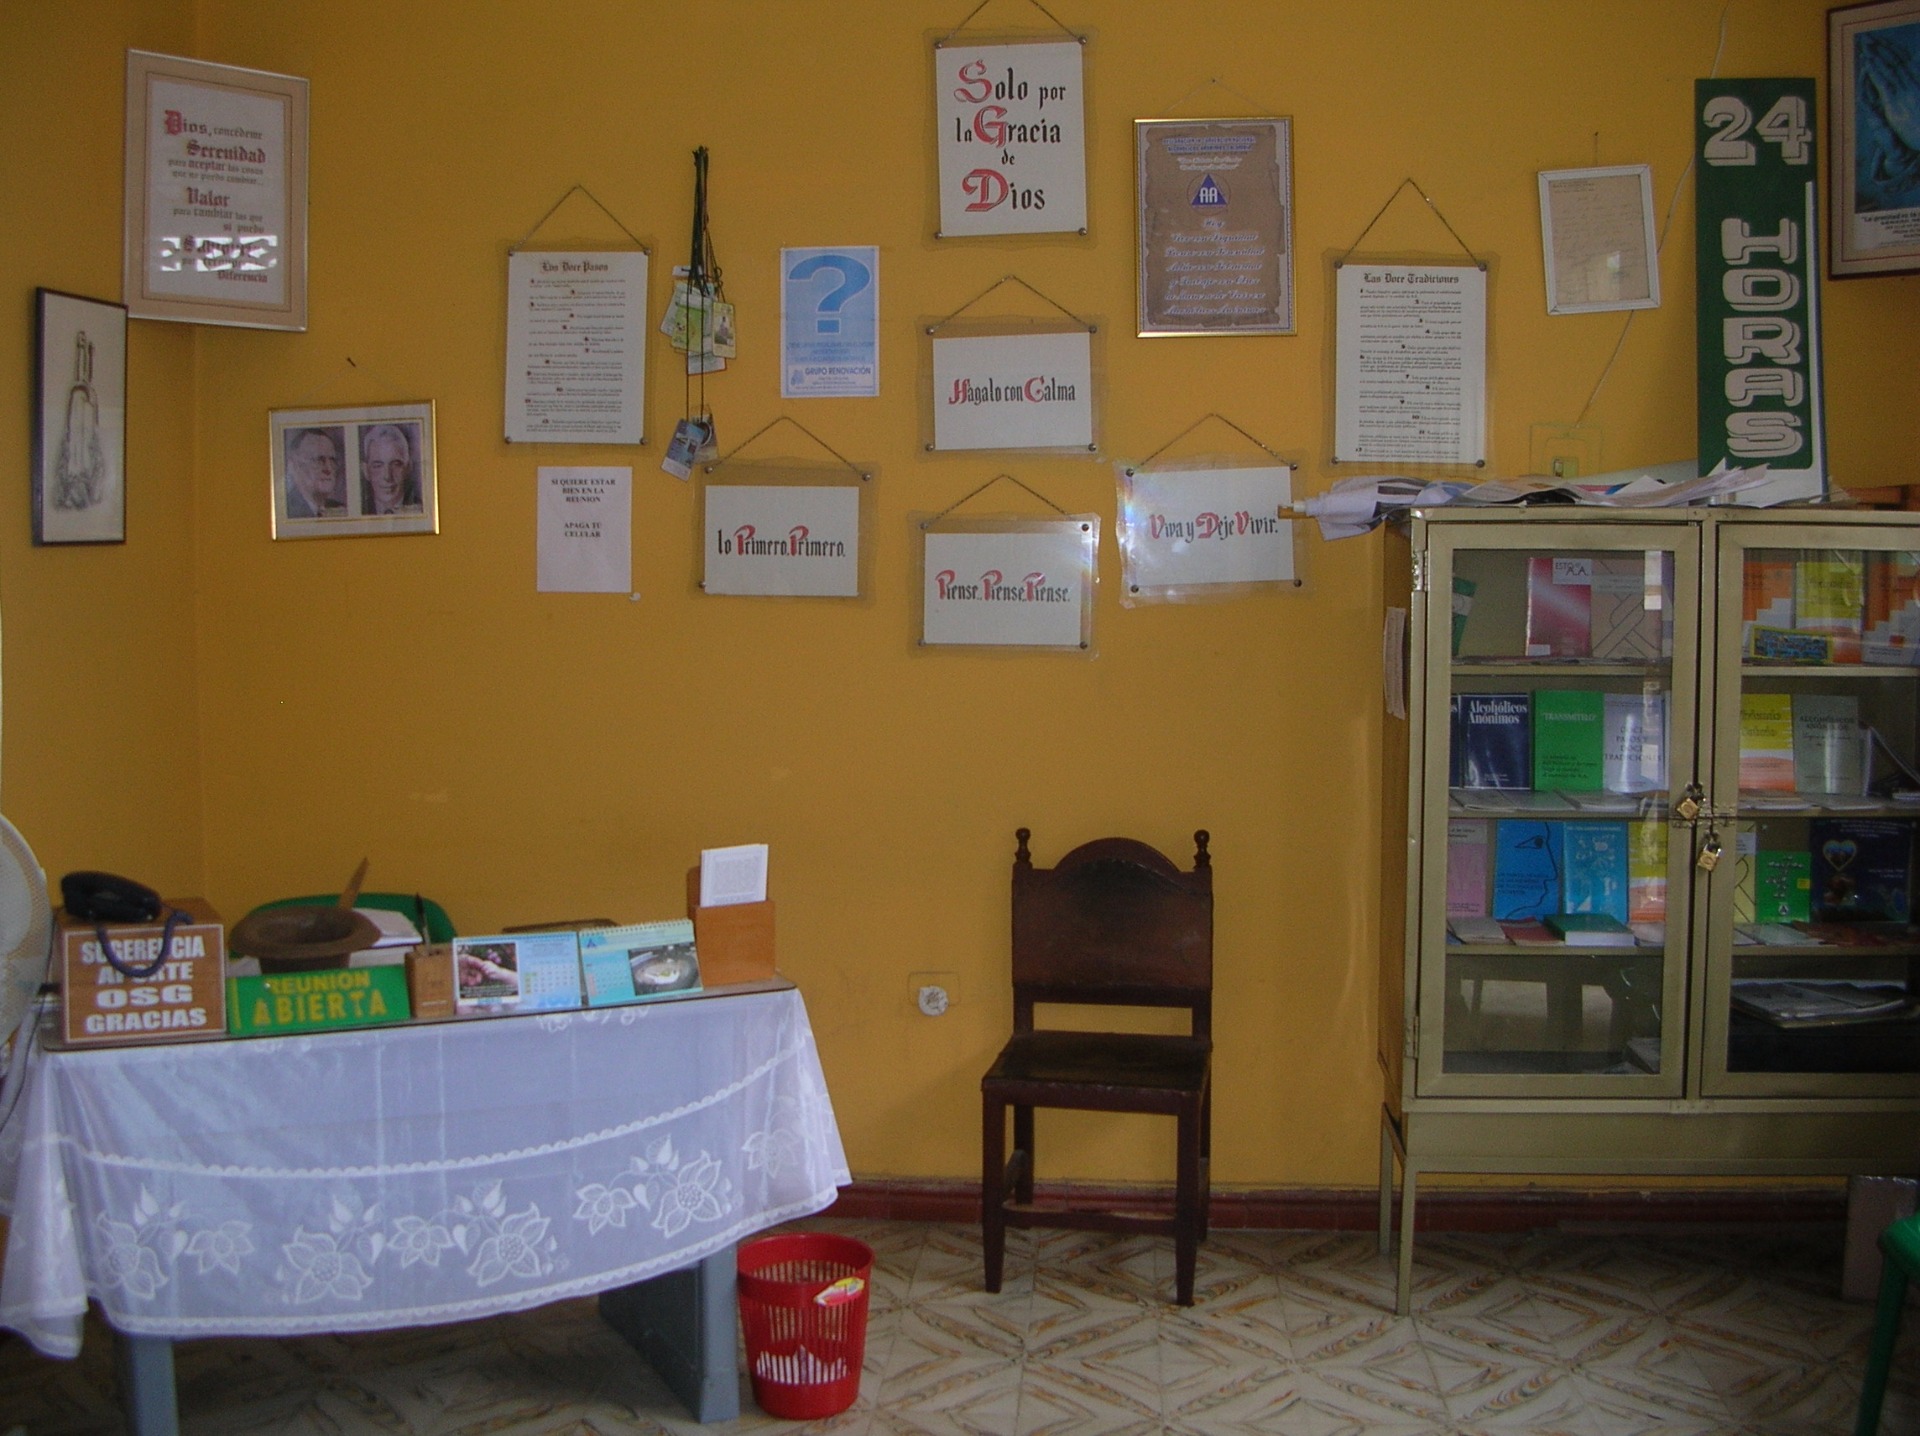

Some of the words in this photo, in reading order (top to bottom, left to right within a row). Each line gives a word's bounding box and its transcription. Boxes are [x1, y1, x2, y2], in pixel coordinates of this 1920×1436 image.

[954, 60, 1028, 103] Solo
[1039, 84, 1066, 110] por
[956, 117, 972, 142] la
[973, 105, 1061, 148] Gracia
[1702, 96, 1812, 166] 24
[186, 139, 266, 164] Serenidad
[1001, 149, 1015, 165] de
[186, 186, 231, 208] Valor
[962, 169, 1045, 212] Dios
[1199, 187, 1218, 204] AA
[1364, 272, 1382, 284] Las
[1384, 272, 1406, 284] Doce
[1407, 272, 1460, 284] Tradiciones
[1721, 217, 1804, 458] HORAS
[804, 367, 828, 376] GRUPO
[828, 364, 872, 376] RENOVACIÓN
[1004, 385, 1024, 402] con
[1024, 375, 1075, 403] Calma
[562, 487, 580, 495] BIEN
[581, 487, 593, 495] EN
[594, 487, 605, 495] LA
[590, 478, 616, 486] ESTAR
[564, 530, 602, 538] CELULAR
[1149, 514, 1183, 540] Viva
[1185, 520, 1195, 543] y
[1195, 512, 1235, 541] Deje
[1235, 511, 1279, 536] Vivir.
[717, 528, 732, 555] lo
[1468, 711, 1521, 724] Anónimos
[1469, 699, 1528, 714] Alcohólicos
[266, 970, 371, 996] REUNION
[96, 984, 194, 1009] OSG
[252, 988, 388, 1027] ABIERTA
[85, 1006, 208, 1035] GRACIAS
